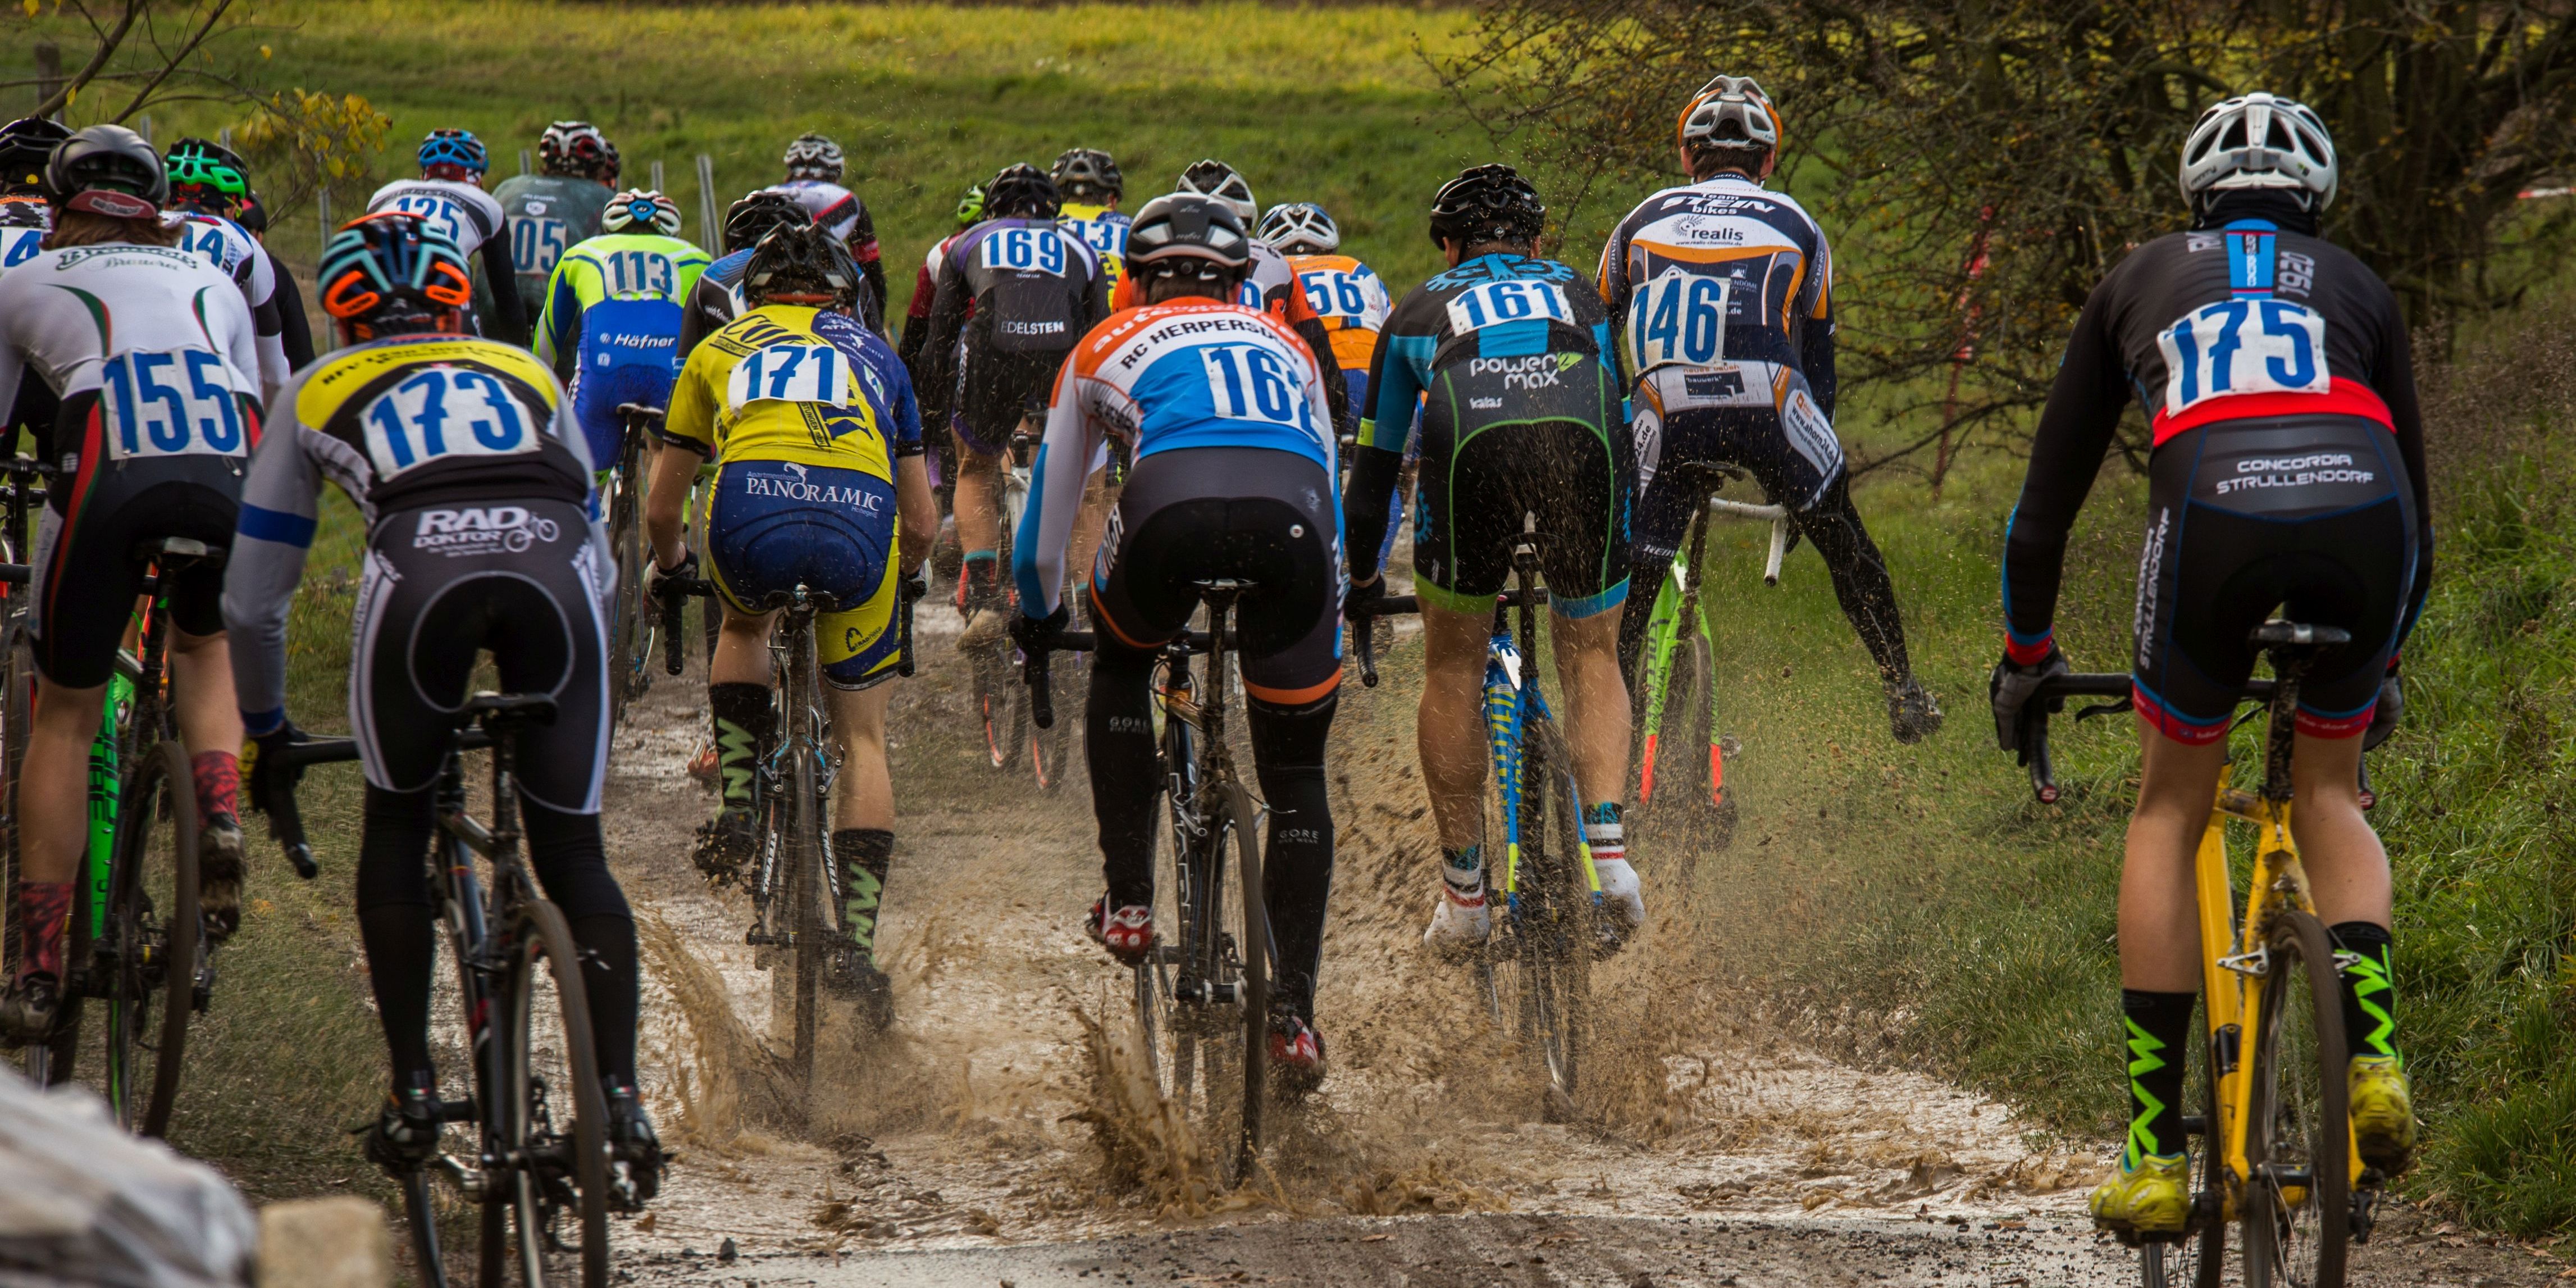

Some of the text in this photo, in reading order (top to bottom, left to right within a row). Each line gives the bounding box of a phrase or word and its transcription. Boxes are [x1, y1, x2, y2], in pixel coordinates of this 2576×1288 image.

[1661, 195, 1776, 213] STEIN
[1692, 205, 1738, 215] bikes
[1702, 193, 1739, 201] Team
[1692, 227, 1744, 240] realis
[984, 231, 1064, 273] 169
[608, 251, 673, 295] 113
[2277, 251, 2315, 298] 1920
[1456, 282, 1563, 327] 161
[1001, 321, 1065, 335] EDELSTEN
[1634, 277, 1722, 369] 146
[614, 333, 676, 349] Häfner
[2164, 301, 2317, 406] 175
[1121, 343, 1148, 370] RC
[1470, 353, 1558, 377] power
[743, 346, 835, 402] 171
[1504, 367, 1560, 390] max
[103, 349, 241, 453] 155
[1469, 396, 1503, 410] kalas
[371, 371, 523, 468] 173
[746, 471, 800, 481] Apartmenthotel
[2237, 453, 2352, 474] CONCORDIA
[745, 477, 883, 511] PANORAMIC
[2217, 469, 2374, 495] STRULLENDORF
[417, 507, 530, 535] RAD
[413, 530, 503, 548] DOKTOR
[2139, 507, 2170, 670] STRULLENDORF
[1279, 829, 1319, 840] GORE
[821, 829, 841, 896] STEVENS
